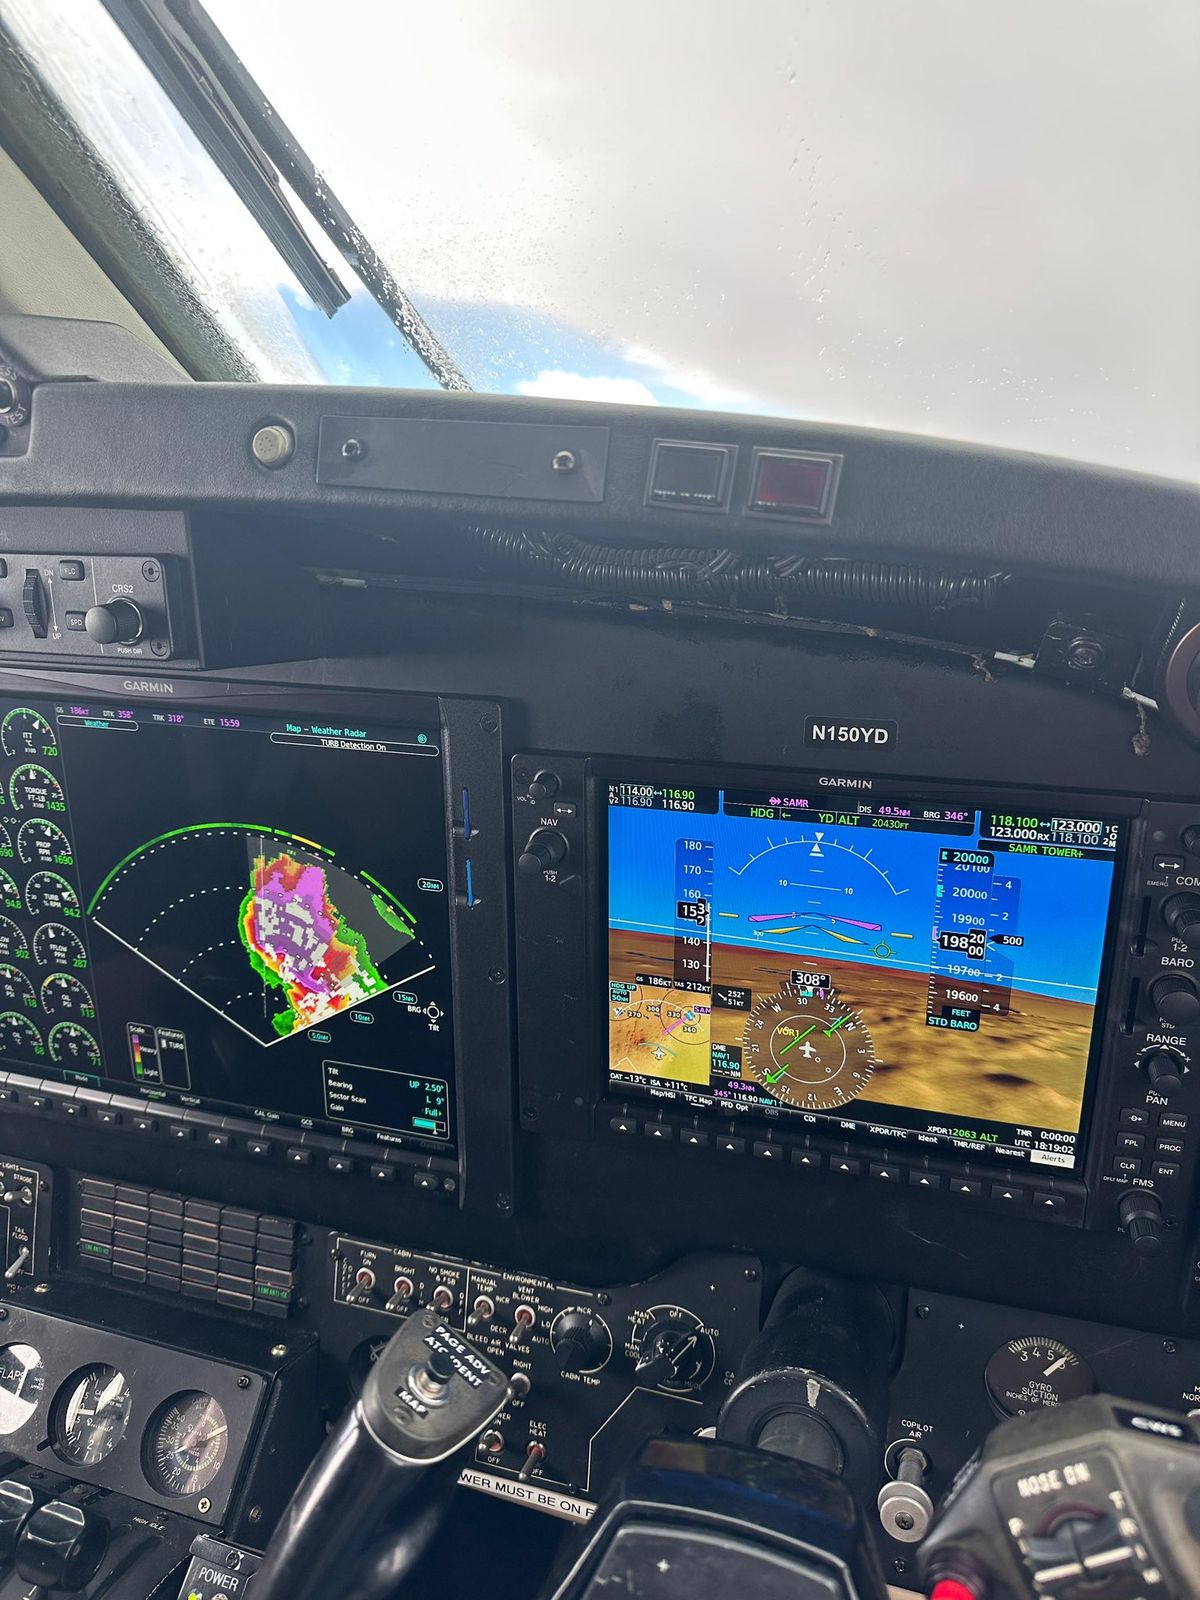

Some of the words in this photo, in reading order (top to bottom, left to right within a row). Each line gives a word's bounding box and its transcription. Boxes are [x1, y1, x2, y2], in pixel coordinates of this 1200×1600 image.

[112, 584, 134, 594] CRS2
[123, 680, 174, 694] GARMIN
[220, 718, 240, 728] 15:59
[286, 724, 301, 734] Map
[312, 726, 342, 736] Weather
[344, 728, 366, 738] Radar
[812, 724, 888, 744] N150YD
[320, 738, 340, 748] TURB
[340, 740, 374, 750] Detection
[376, 743, 386, 751] On
[42, 746, 58, 756] 720
[818, 776, 872, 790] GARMIN
[620, 786, 653, 797] 114.00
[662, 788, 696, 800] 116.90
[620, 796, 653, 807] 116.90
[662, 800, 696, 811] 116.90
[782, 798, 809, 808] SAMR
[924, 811, 940, 819] BRG
[944, 812, 968, 820] 346°
[540, 818, 558, 826] NAV
[750, 808, 774, 819] HDG
[818, 813, 834, 824] YD
[838, 815, 860, 826] ALT
[991, 814, 1038, 828] 118.100
[1053, 819, 1100, 834] 123.000
[1052, 832, 1099, 845] 118.100
[684, 840, 702, 850] 180
[1008, 844, 1038, 854] SAMR
[953, 852, 989, 864] 20000
[684, 864, 702, 875] 170
[684, 888, 701, 899] 160
[952, 887, 988, 900] 20000
[952, 913, 985, 926] 19900
[682, 936, 700, 946] 140
[1002, 936, 1022, 946] 500
[1172, 943, 1188, 952] 1-2
[682, 959, 700, 969] 130
[1161, 956, 1194, 968] BARO
[948, 964, 980, 976] 19700
[796, 972, 826, 986] 308°
[686, 982, 710, 992] 212KT
[946, 989, 978, 1002] 19600
[408, 1005, 422, 1014] BRG
[952, 1008, 971, 1018] FEET
[928, 1016, 948, 1026] STD
[950, 1020, 978, 1030] BARO
[1146, 1033, 1187, 1046] RANGE
[712, 1059, 740, 1070] 116.90
[328, 1079, 352, 1091] Bearing
[329, 1092, 350, 1101] Sector
[351, 1094, 366, 1104] Scan
[684, 1094, 698, 1102] TFC
[733, 1092, 758, 1104] 116.90
[1146, 1096, 1168, 1106] PAN
[330, 1104, 344, 1112] Gain
[720, 1100, 734, 1108] PFD
[736, 1103, 748, 1112] Opt
[425, 1108, 438, 1116] Full
[1162, 1119, 1186, 1128] MENU
[870, 1126, 907, 1138] XPDR/TFC
[952, 1128, 977, 1140] 2063
[980, 1132, 998, 1142] ALT
[1016, 1128, 1032, 1138] TMR
[1040, 1131, 1076, 1143] 0:00:00
[952, 1140, 986, 1151] TMR/REF
[1014, 1138, 1031, 1148] UTC
[1034, 1141, 1074, 1154] 18:19:02
[1124, 1138, 1138, 1147] FPL
[1160, 1144, 1182, 1152] PROC
[995, 1146, 1025, 1158] Nearest
[1042, 1154, 1065, 1164] Alerts
[1120, 1162, 1136, 1170] CLR
[1158, 1168, 1174, 1176] ENT
[1132, 1177, 1154, 1188] FMS
[392, 1248, 412, 1258] CABIN
[394, 1264, 416, 1276] BRIGHT
[440, 1268, 460, 1278] SMOKE
[471, 1274, 498, 1288] MANUAL
[502, 1272, 555, 1290] ENVIRONMENTAL
[476, 1284, 494, 1292] TEMP
[518, 1286, 535, 1295] VENT
[496, 1295, 510, 1304] INCR
[512, 1292, 540, 1304] BLOWER
[538, 1304, 553, 1314] HIGH
[576, 1306, 592, 1315] INCR
[669, 1310, 682, 1319] OFF
[634, 1310, 650, 1320] MAN
[490, 1324, 508, 1334] DECR
[700, 1327, 720, 1337] AUTO
[466, 1332, 488, 1344] BLEED
[490, 1338, 502, 1346] AIR
[505, 1342, 530, 1354] VALVES
[532, 1335, 550, 1345] AUTO
[435, 1326, 466, 1354] PAGE
[464, 1354, 492, 1375] ADV
[486, 1346, 504, 1357] OPEN
[624, 1342, 640, 1352] MAN
[1020, 1350, 1029, 1362] 3
[1047, 1350, 1054, 1360] 5
[513, 1359, 532, 1370] RIGHT
[450, 1355, 483, 1387] DENT
[560, 1370, 580, 1382] CABIN
[583, 1376, 600, 1386] TEMP
[1028, 1380, 1052, 1392] GYRO
[1006, 1390, 1028, 1401] INCHES
[1022, 1386, 1058, 1402] SUCTION
[398, 1390, 428, 1413] MAP
[530, 1420, 547, 1430] ELEC
[902, 1419, 934, 1433] COPILOT
[530, 1428, 547, 1438] HEAT
[909, 1430, 922, 1440] AIR
[172, 1466, 182, 1476] 20
[1017, 1469, 1063, 1498] NOSE
[495, 1480, 534, 1500] MUST
[538, 1493, 557, 1506] BE
[560, 1500, 581, 1514] ON
[198, 1566, 240, 1592] POWER
